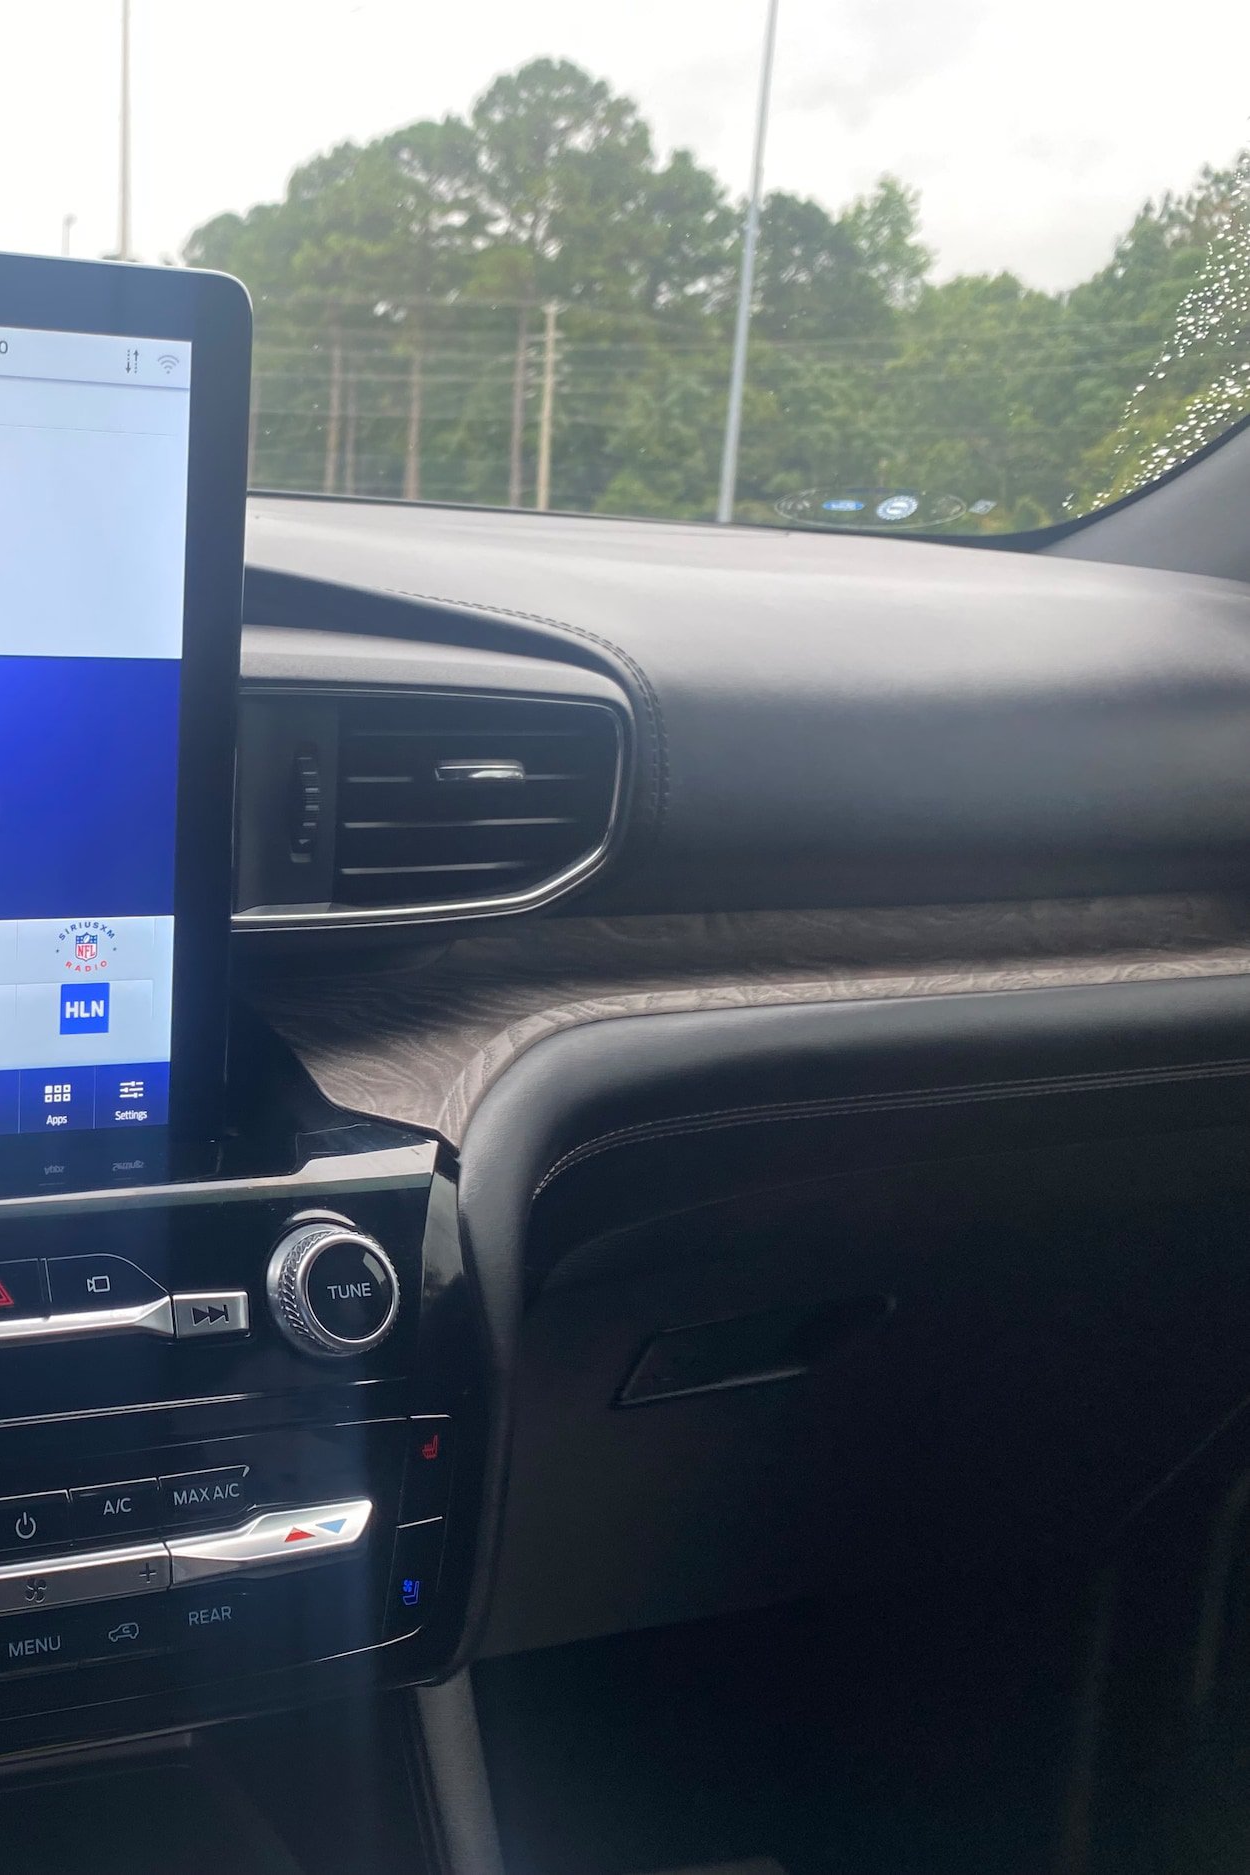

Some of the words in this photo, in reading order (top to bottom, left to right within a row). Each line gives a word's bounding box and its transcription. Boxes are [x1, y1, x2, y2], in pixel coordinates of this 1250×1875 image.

[58, 921, 116, 941] SIRIUSXM
[77, 944, 96, 959] NFL
[65, 960, 108, 973] RADIO
[65, 999, 105, 1019] HLN
[46, 1114, 68, 1127] Apps
[114, 1109, 148, 1122] Settings
[326, 1282, 372, 1300] TUNE
[173, 1487, 210, 1506] MAX
[213, 1483, 240, 1500] A/C
[103, 1498, 132, 1515] A/C
[188, 1606, 232, 1626] REAR
[8, 1635, 62, 1658] MENU
